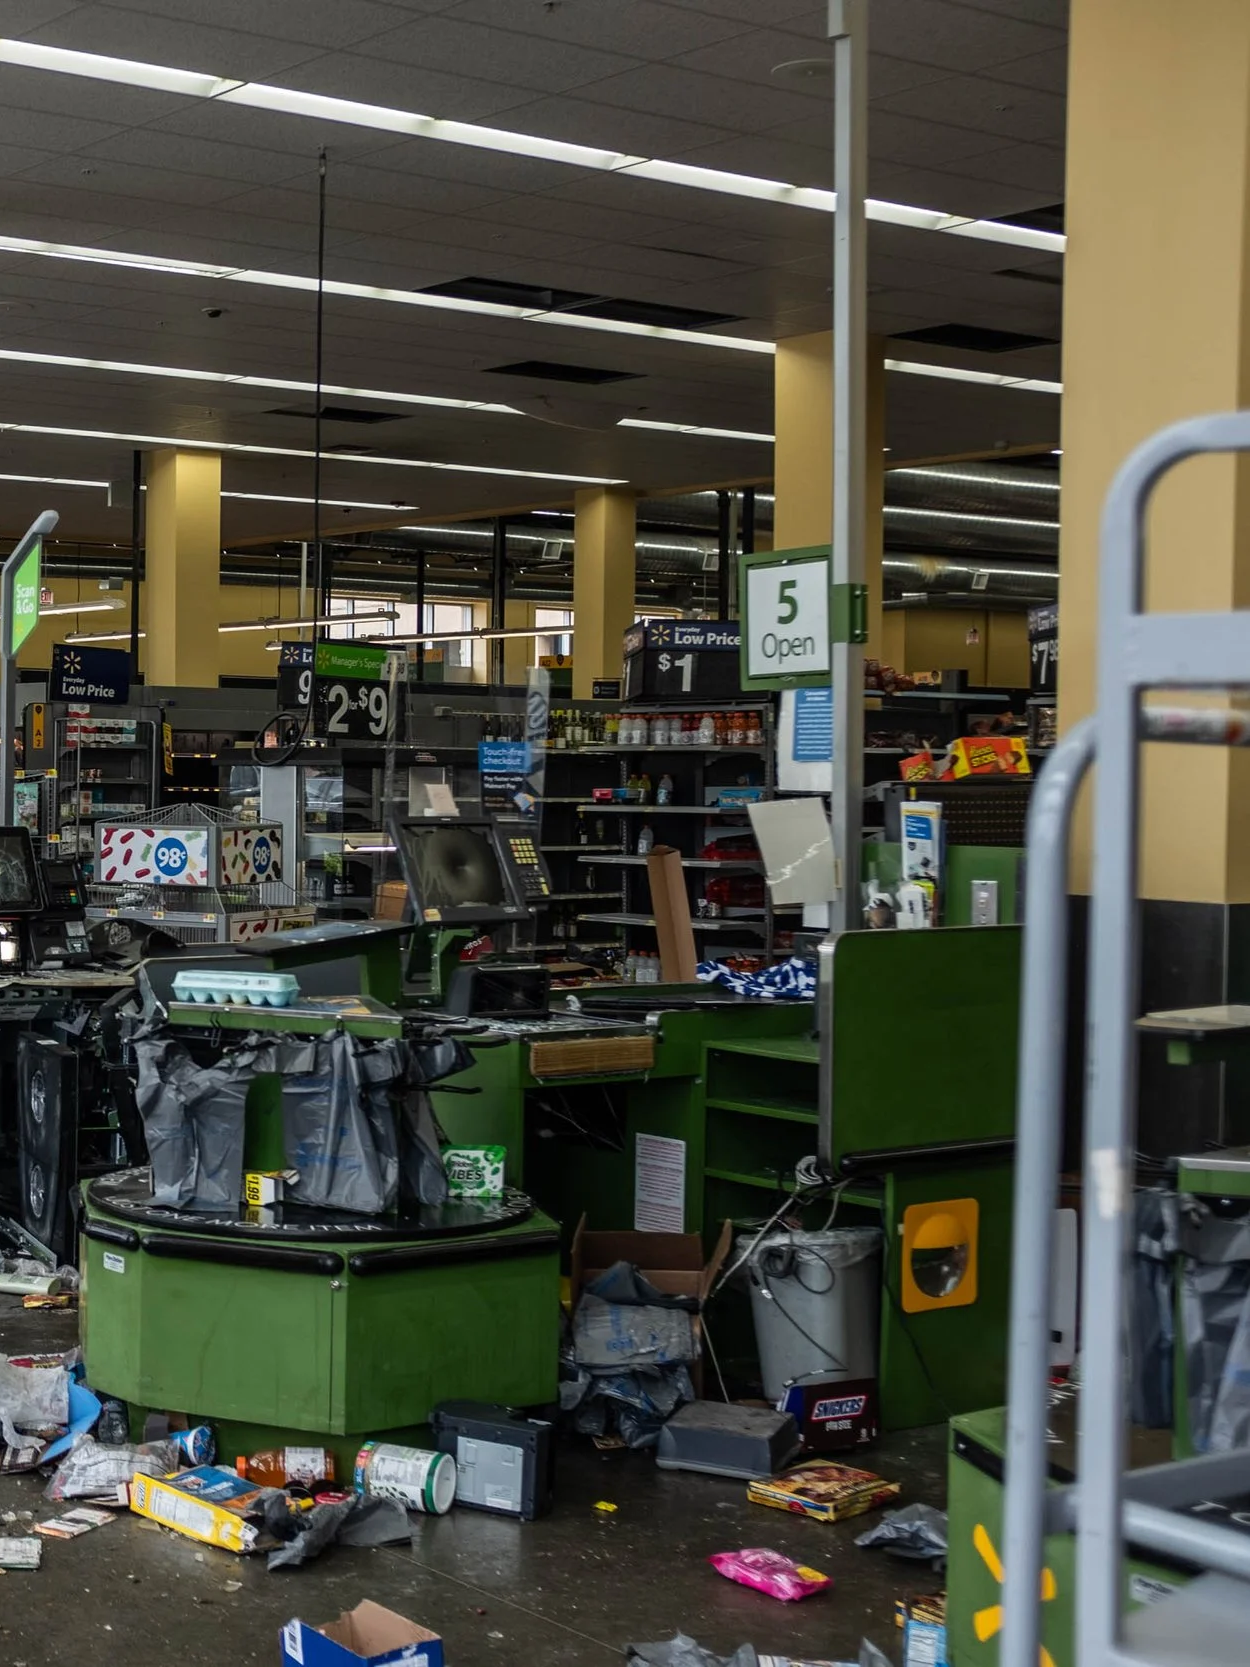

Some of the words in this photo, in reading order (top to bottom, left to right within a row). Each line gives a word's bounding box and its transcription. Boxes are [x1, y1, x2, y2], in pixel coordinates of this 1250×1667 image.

[15, 584, 35, 598] Scan
[777, 580, 799, 625] 5
[674, 633, 704, 645] Low
[706, 633, 741, 645] Price
[762, 633, 815, 664] Open
[331, 655, 363, 669] Manager's
[63, 676, 85, 684] Everyday
[658, 653, 693, 692] $1
[62, 683, 86, 696] Low
[87, 685, 115, 698] Price
[328, 684, 350, 733] 2
[483, 757, 521, 765] checkout
[146, 1210, 206, 1221] ONE
[205, 1219, 299, 1231] MORE
[310, 1224, 383, 1232] ITEM
[814, 1398, 863, 1418] SNICKERS
